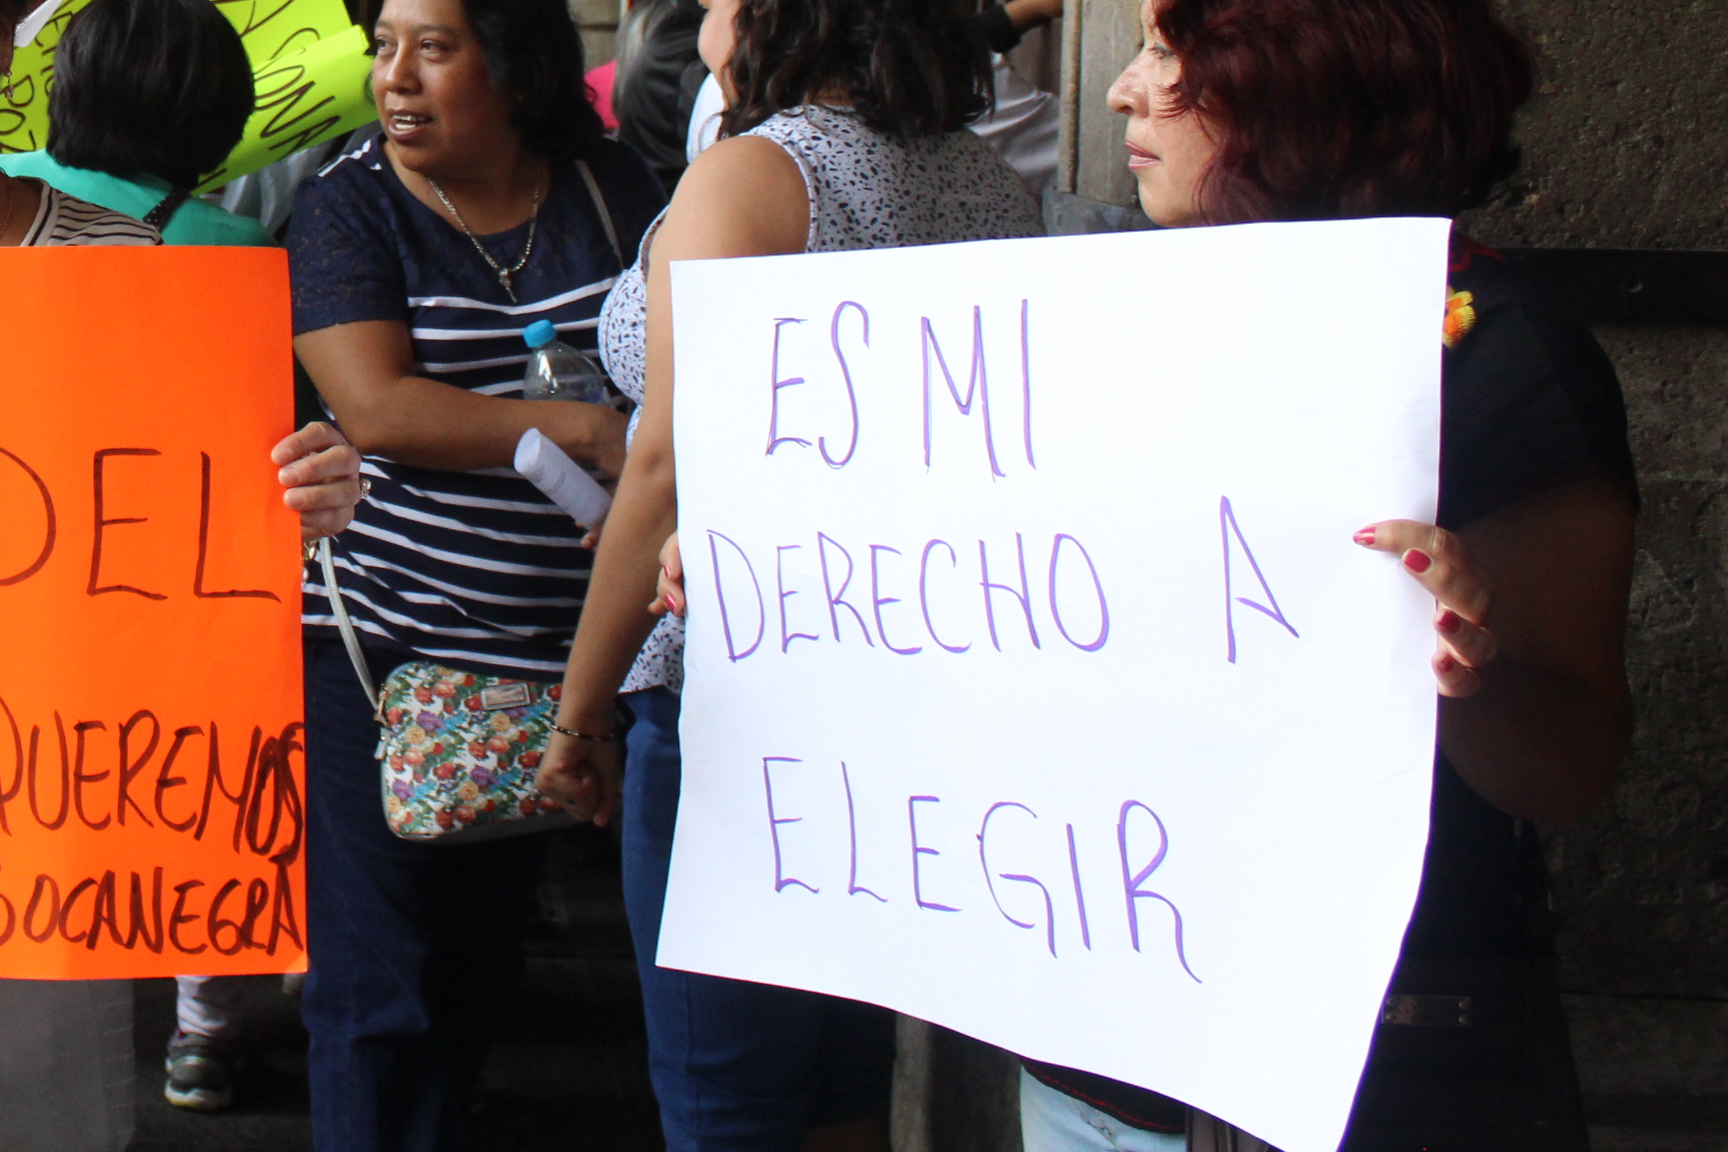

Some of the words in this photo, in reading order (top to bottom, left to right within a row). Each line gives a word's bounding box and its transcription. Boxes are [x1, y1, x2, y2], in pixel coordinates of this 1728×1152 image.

[765, 299, 870, 470] ES
[920, 298, 1037, 480] MI
[706, 528, 1110, 665] DERECHO
[1218, 494, 1302, 665] A
[762, 756, 1203, 984] ELEGIR
